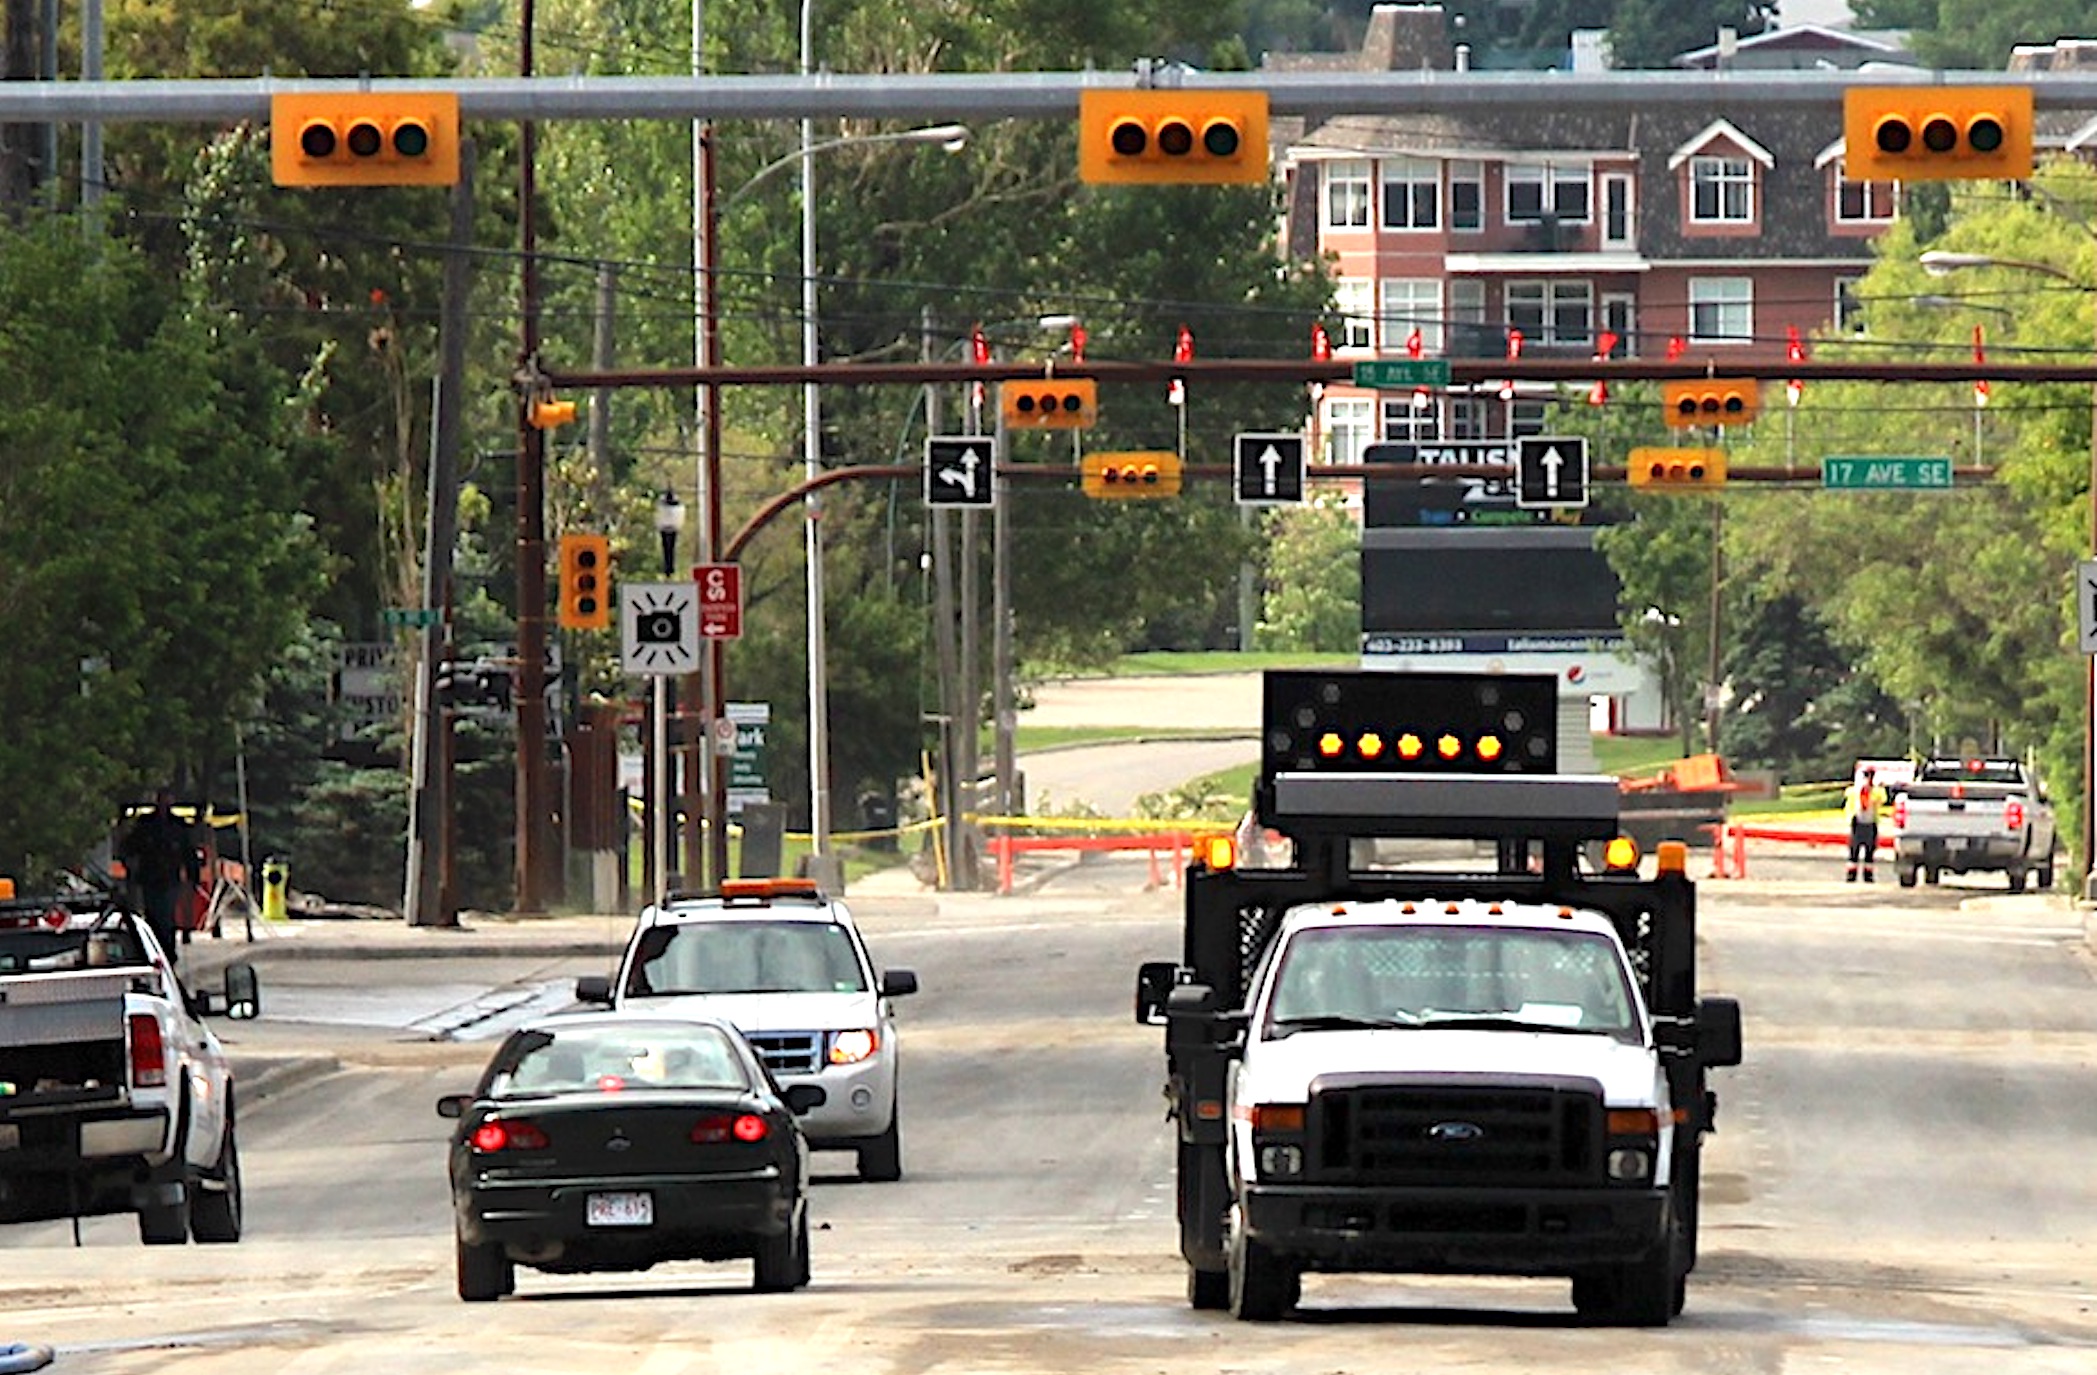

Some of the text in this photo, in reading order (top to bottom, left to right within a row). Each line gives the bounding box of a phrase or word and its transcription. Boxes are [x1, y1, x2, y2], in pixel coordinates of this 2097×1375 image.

[1418, 448, 1516, 466] TALIS
[1830, 462, 1946, 485] 17 AVE SE
